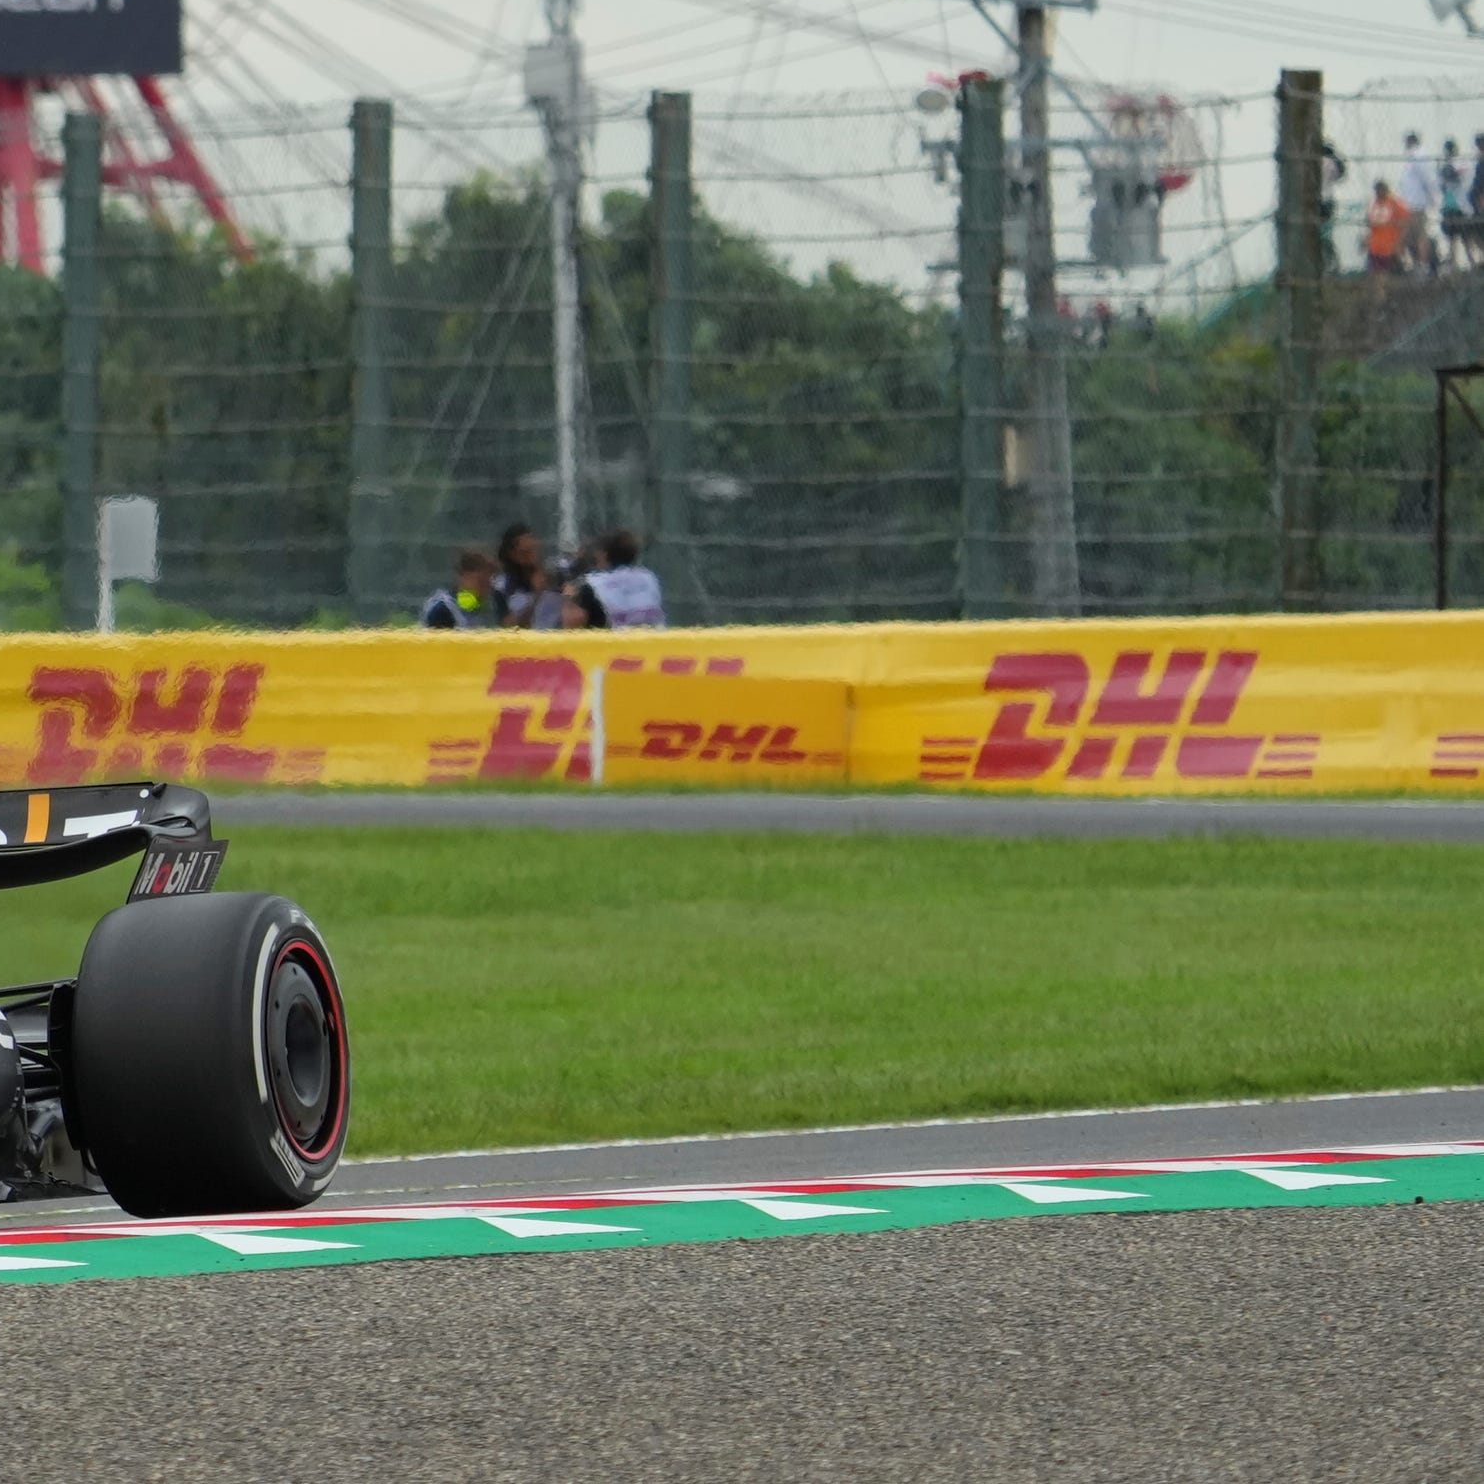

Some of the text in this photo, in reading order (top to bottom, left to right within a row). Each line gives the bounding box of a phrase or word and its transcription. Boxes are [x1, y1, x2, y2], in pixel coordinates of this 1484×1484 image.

[26, 663, 277, 784] DHL
[640, 721, 806, 764] DHL
[974, 650, 1265, 781] DHL
[134, 851, 200, 894] Mobil
